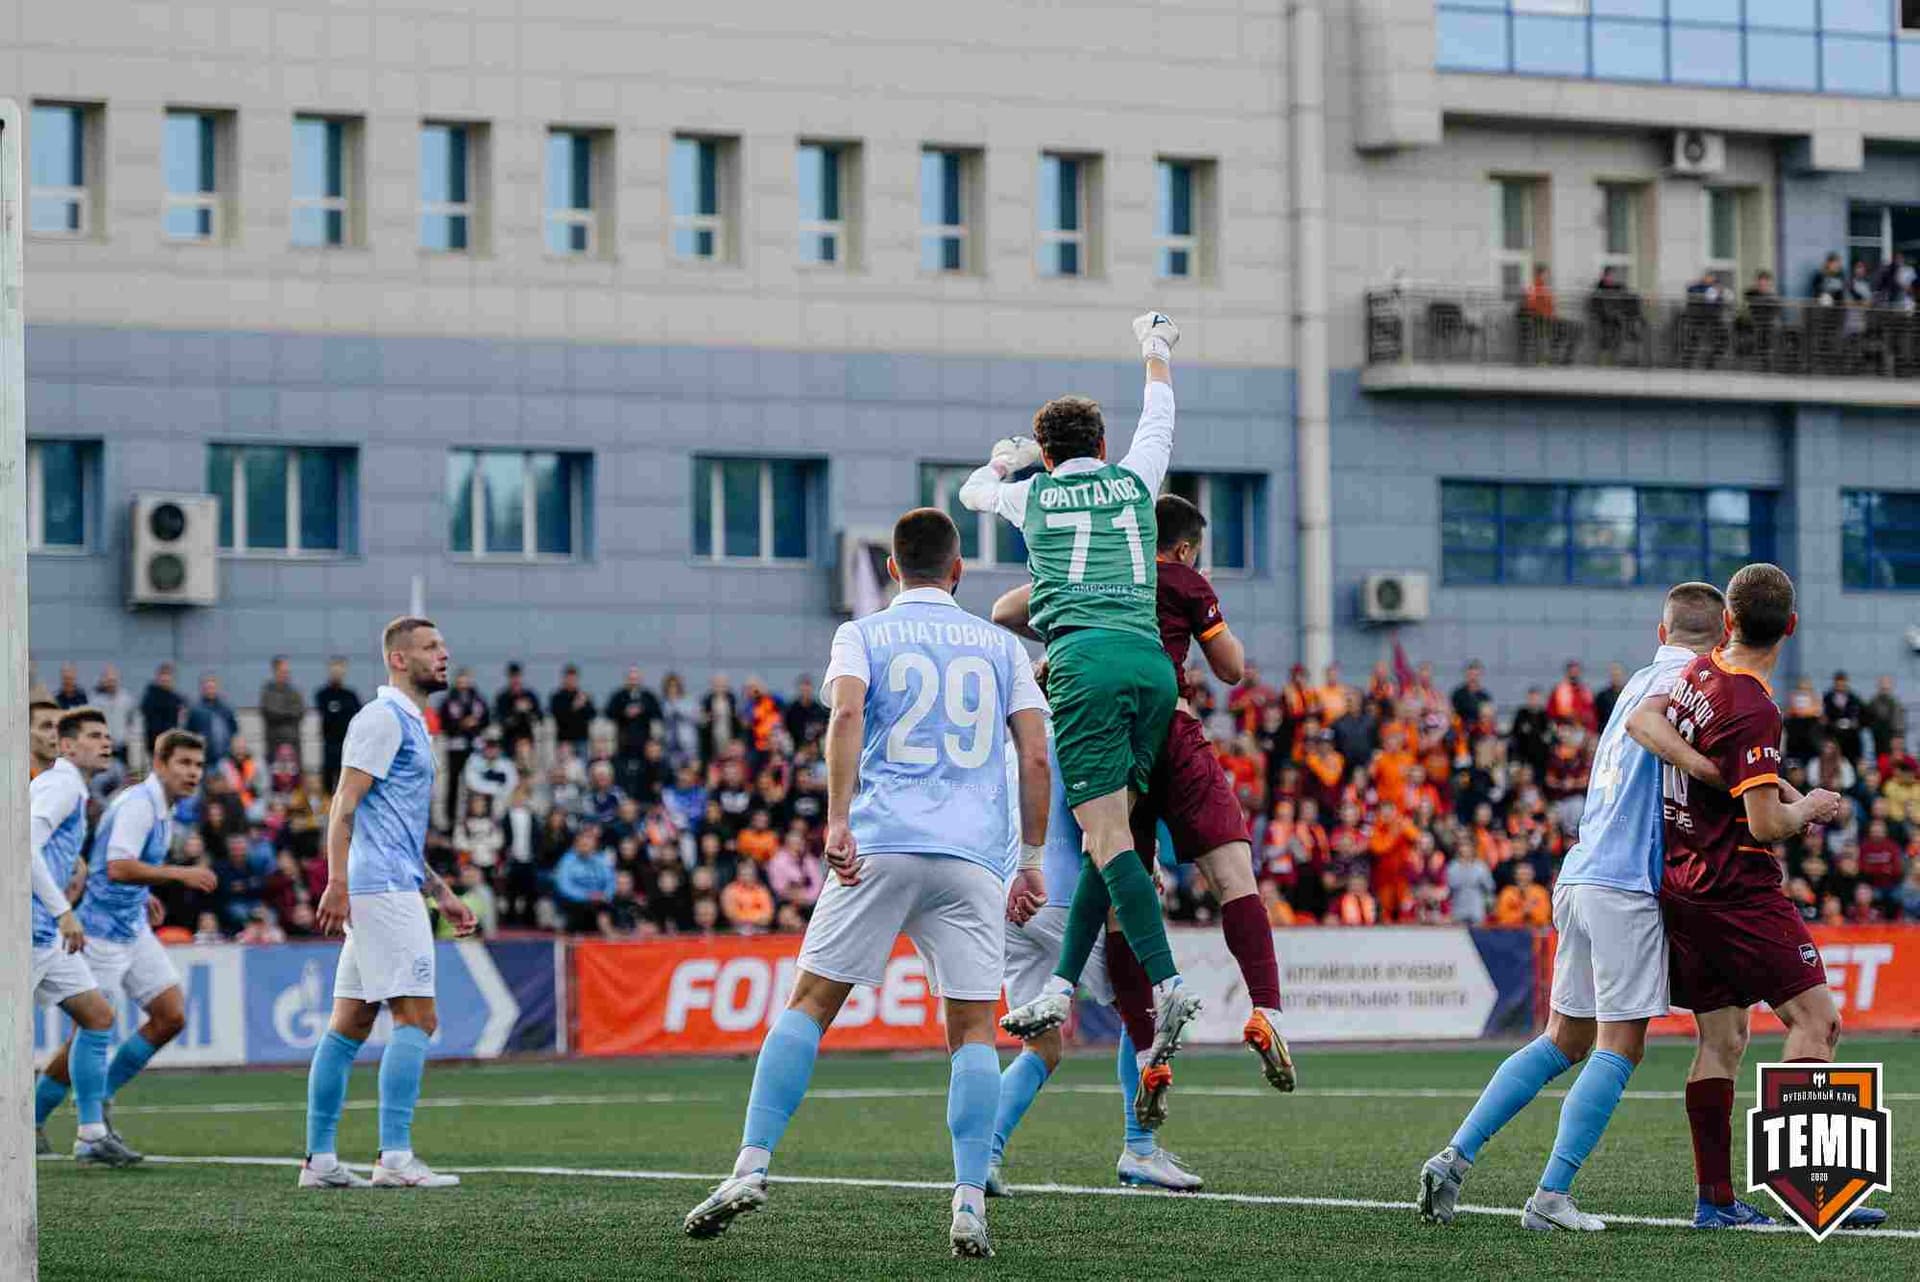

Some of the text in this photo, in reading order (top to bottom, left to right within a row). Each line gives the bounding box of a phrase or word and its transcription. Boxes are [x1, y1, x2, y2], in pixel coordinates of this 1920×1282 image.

[1040, 476, 1141, 508] ФАТТАХОВ
[1046, 505, 1147, 585] 71
[867, 620, 1006, 656] ИГНАТОВИЧ
[886, 652, 998, 769] 29
